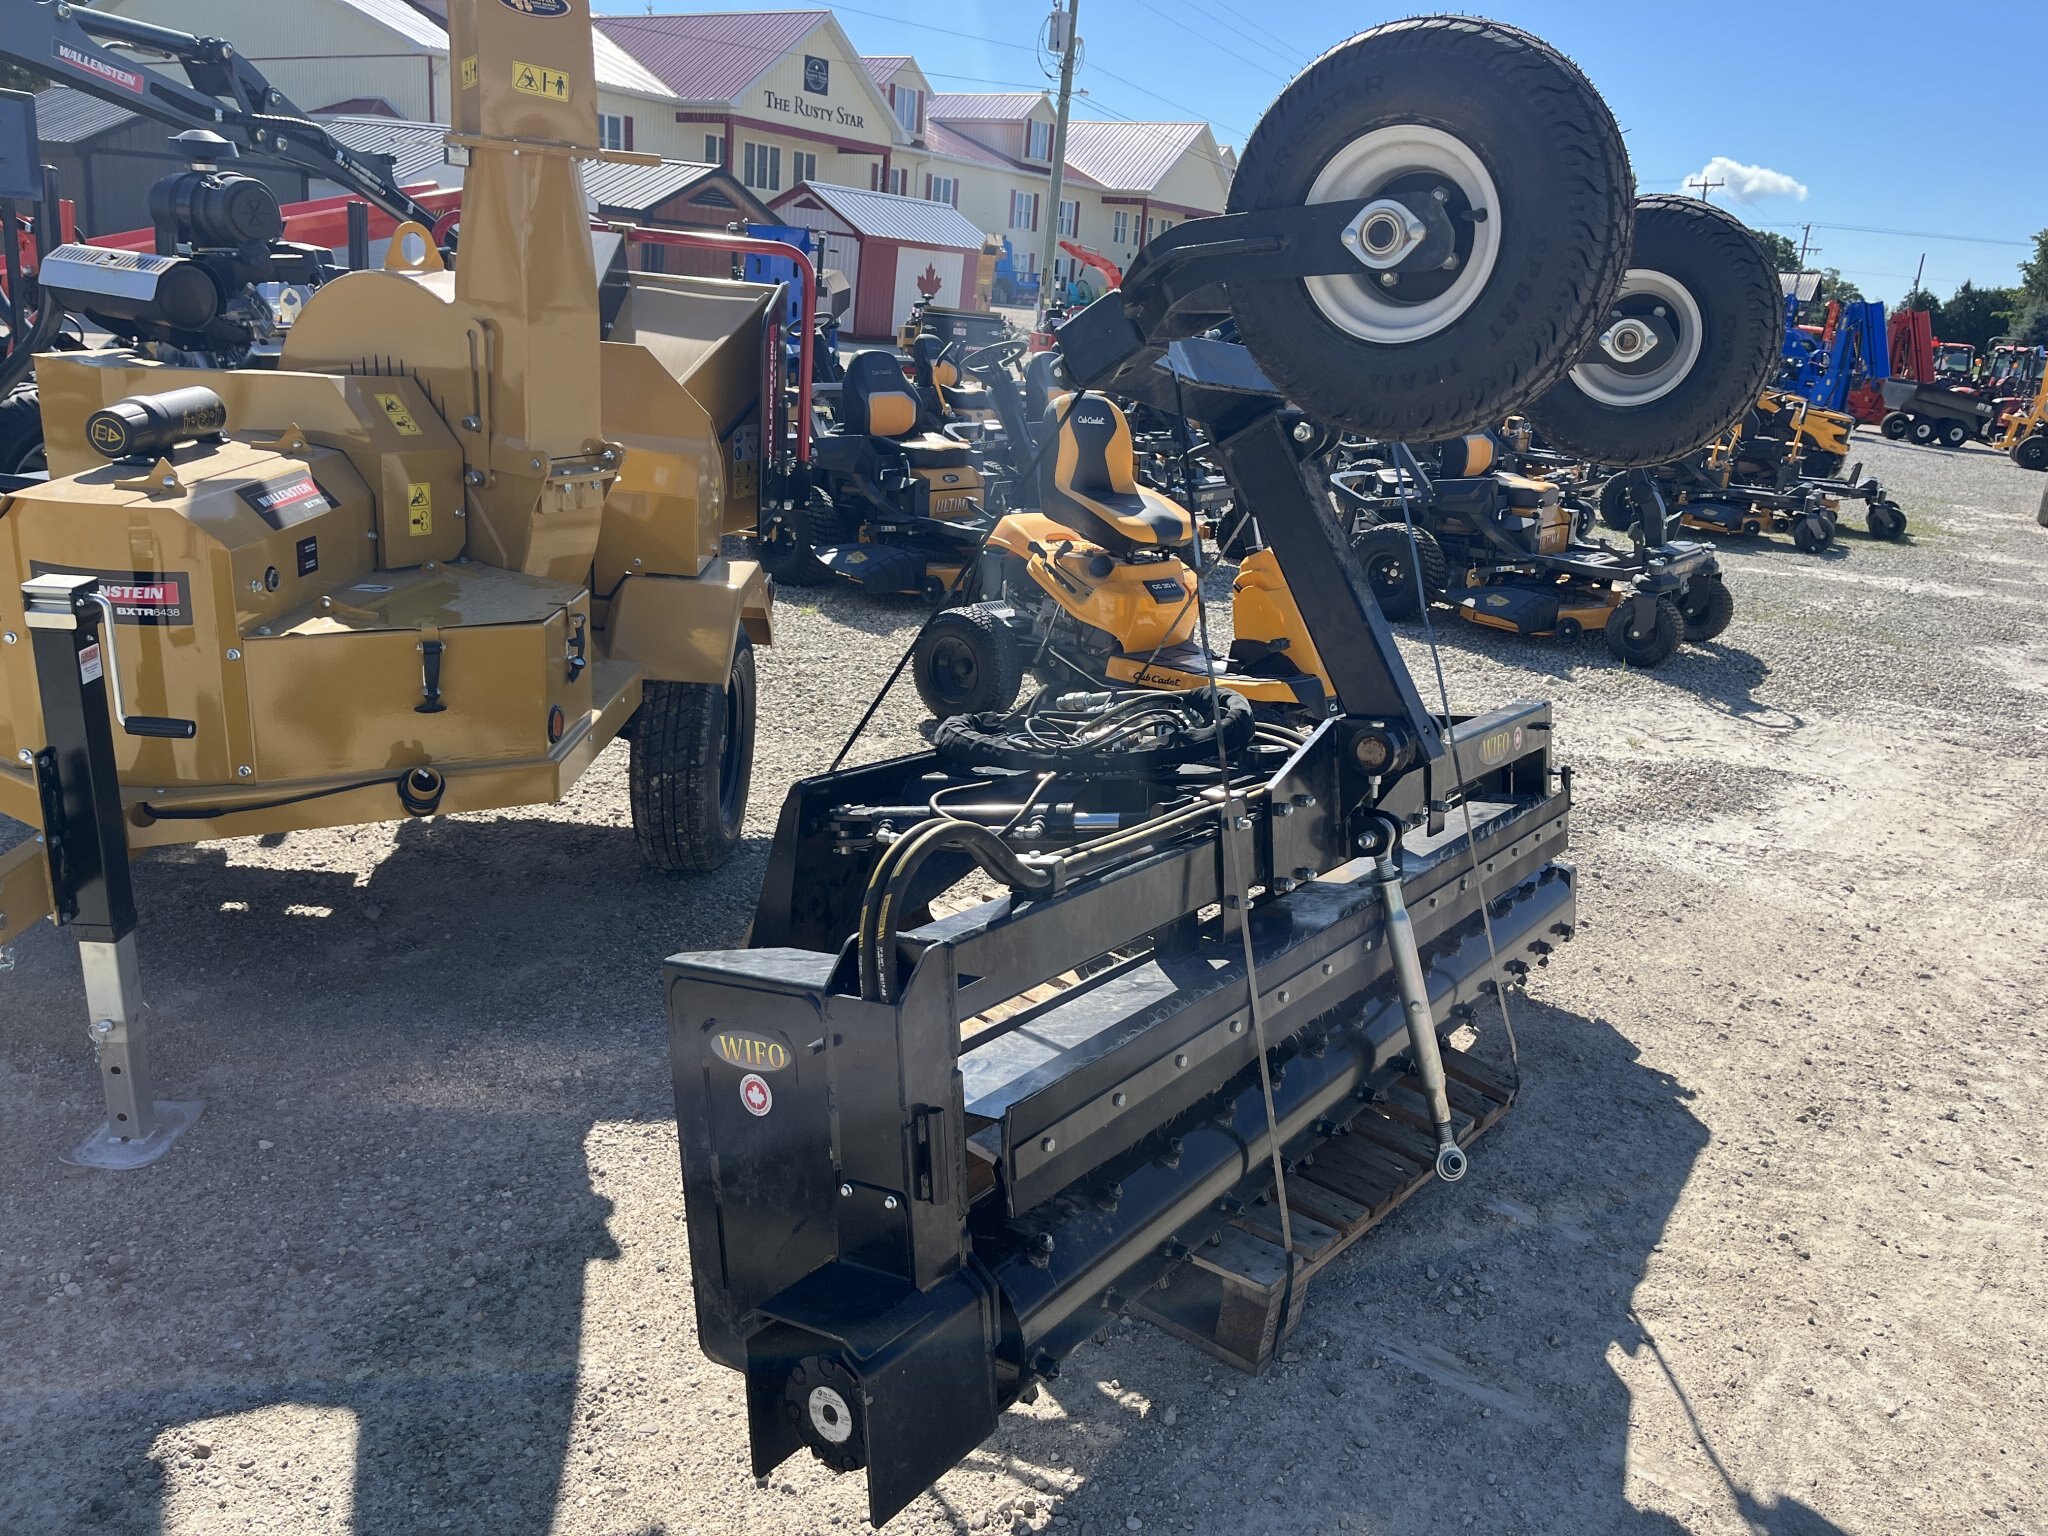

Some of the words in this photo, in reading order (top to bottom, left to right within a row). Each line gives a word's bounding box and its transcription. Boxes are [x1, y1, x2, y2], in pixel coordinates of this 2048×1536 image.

[59, 45, 136, 86] WALLENSTEIN
[1078, 415, 1088, 424] Cub
[1088, 416, 1105, 425] Cadet
[257, 481, 313, 508] WALLENSTEIN
[99, 584, 164, 600] NSTEIN
[116, 606, 181, 617] BXTR6438
[1151, 674, 1182, 687] Cadet
[1482, 731, 1510, 762] WIFO
[718, 1034, 786, 1069] WIFO
